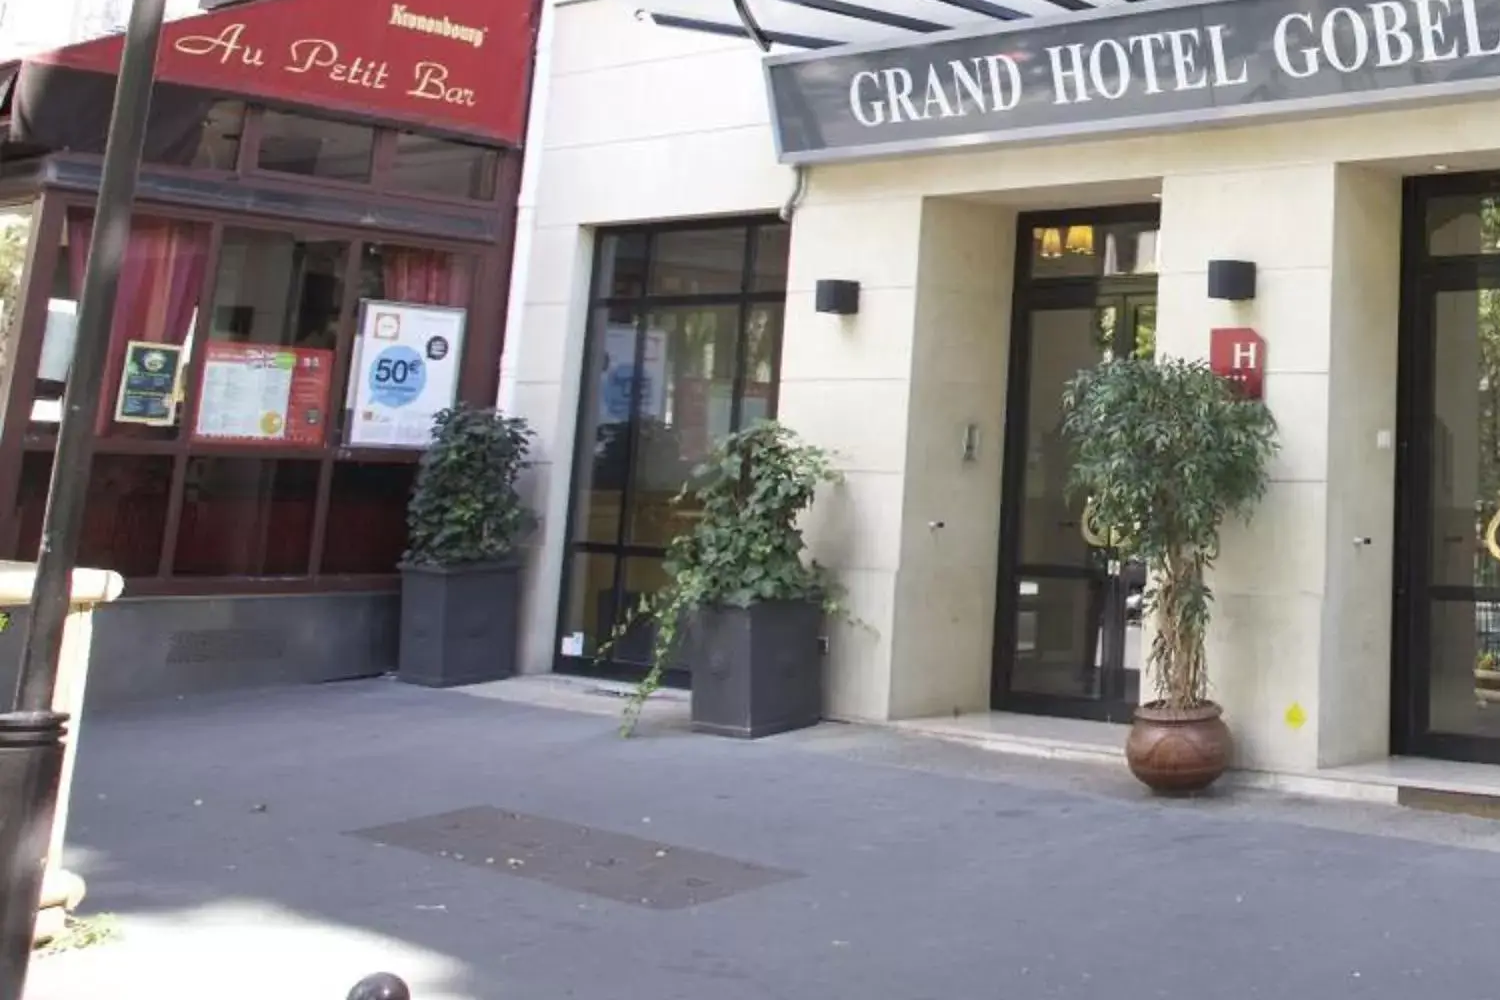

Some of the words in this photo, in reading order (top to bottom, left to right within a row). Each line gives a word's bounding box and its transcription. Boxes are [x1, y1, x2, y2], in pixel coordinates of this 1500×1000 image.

[388, 3, 485, 48] Kronenbourg
[175, 23, 264, 65] Au
[284, 39, 389, 89] Petit
[406, 60, 477, 107] Bar
[850, 54, 1022, 127] GRAND
[1044, 23, 1248, 105] HOTEL
[1232, 342, 1257, 369] H
